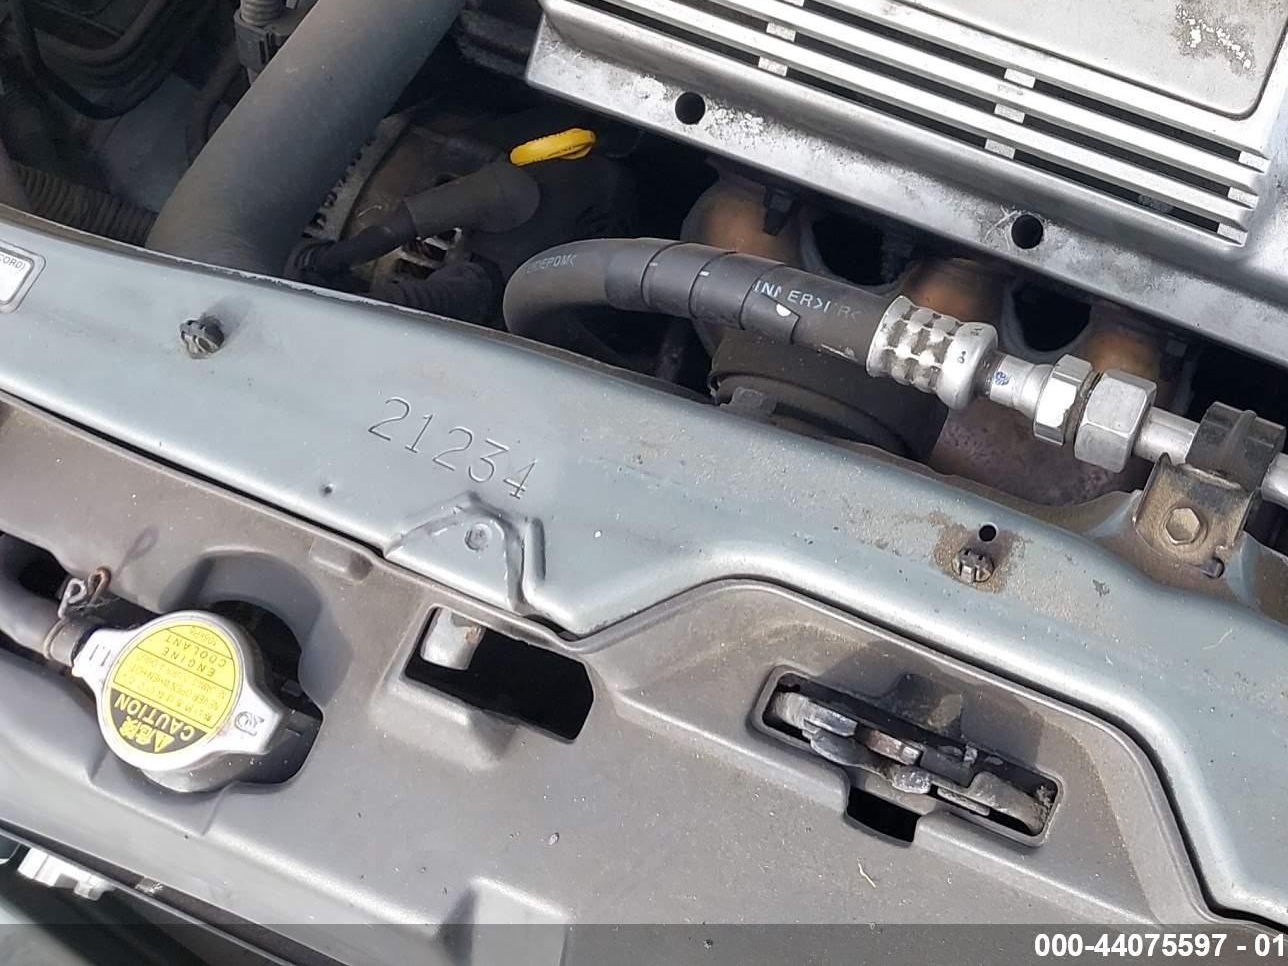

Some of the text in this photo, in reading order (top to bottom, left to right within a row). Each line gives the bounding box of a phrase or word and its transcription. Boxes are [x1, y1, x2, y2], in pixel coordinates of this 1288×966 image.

[368, 395, 539, 500] 21234
[160, 645, 216, 678] ENGINE
[163, 633, 227, 669] COOLANT
[114, 693, 196, 741] CAUTION
